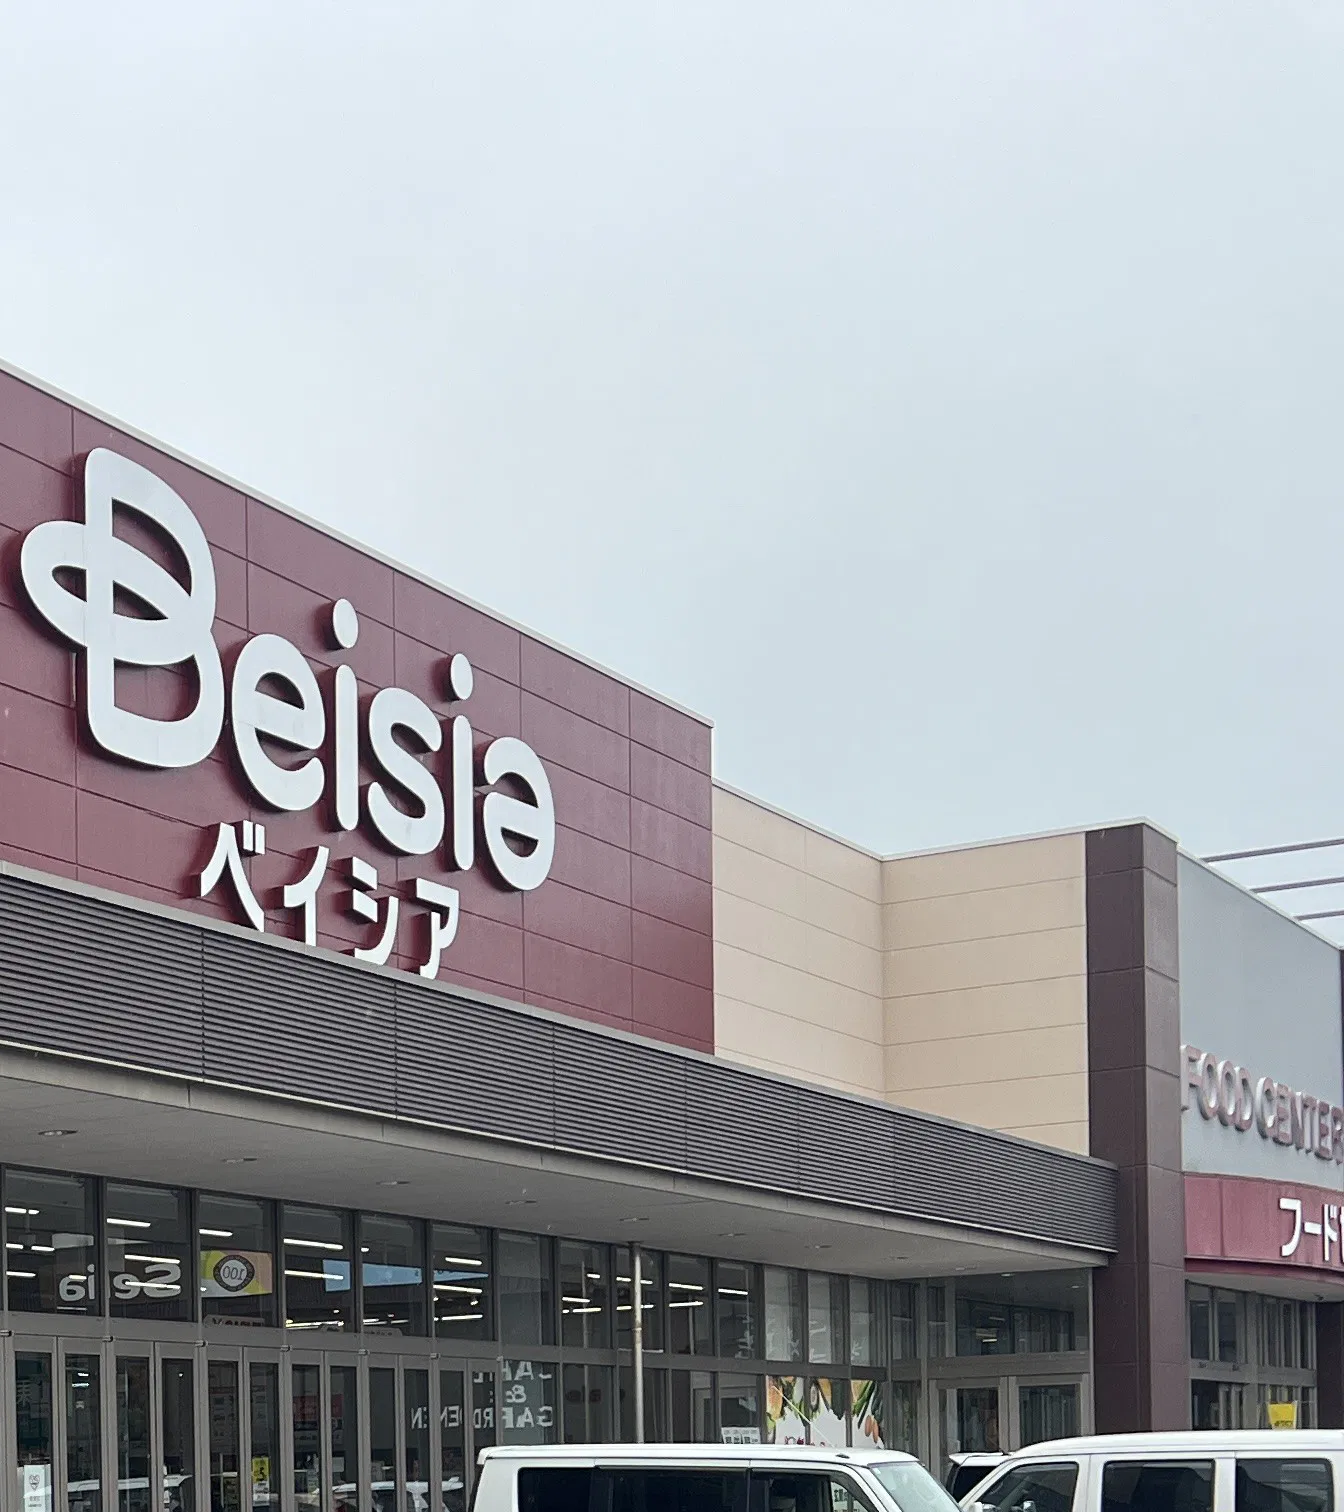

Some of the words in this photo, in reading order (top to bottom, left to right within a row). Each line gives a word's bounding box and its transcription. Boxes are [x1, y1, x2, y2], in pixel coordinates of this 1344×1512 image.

[20, 447, 556, 892] Beisia
[199, 820, 460, 980] ベイシア
[1180, 1044, 1254, 1132] FOOD
[1278, 1197, 1344, 1262] フード
